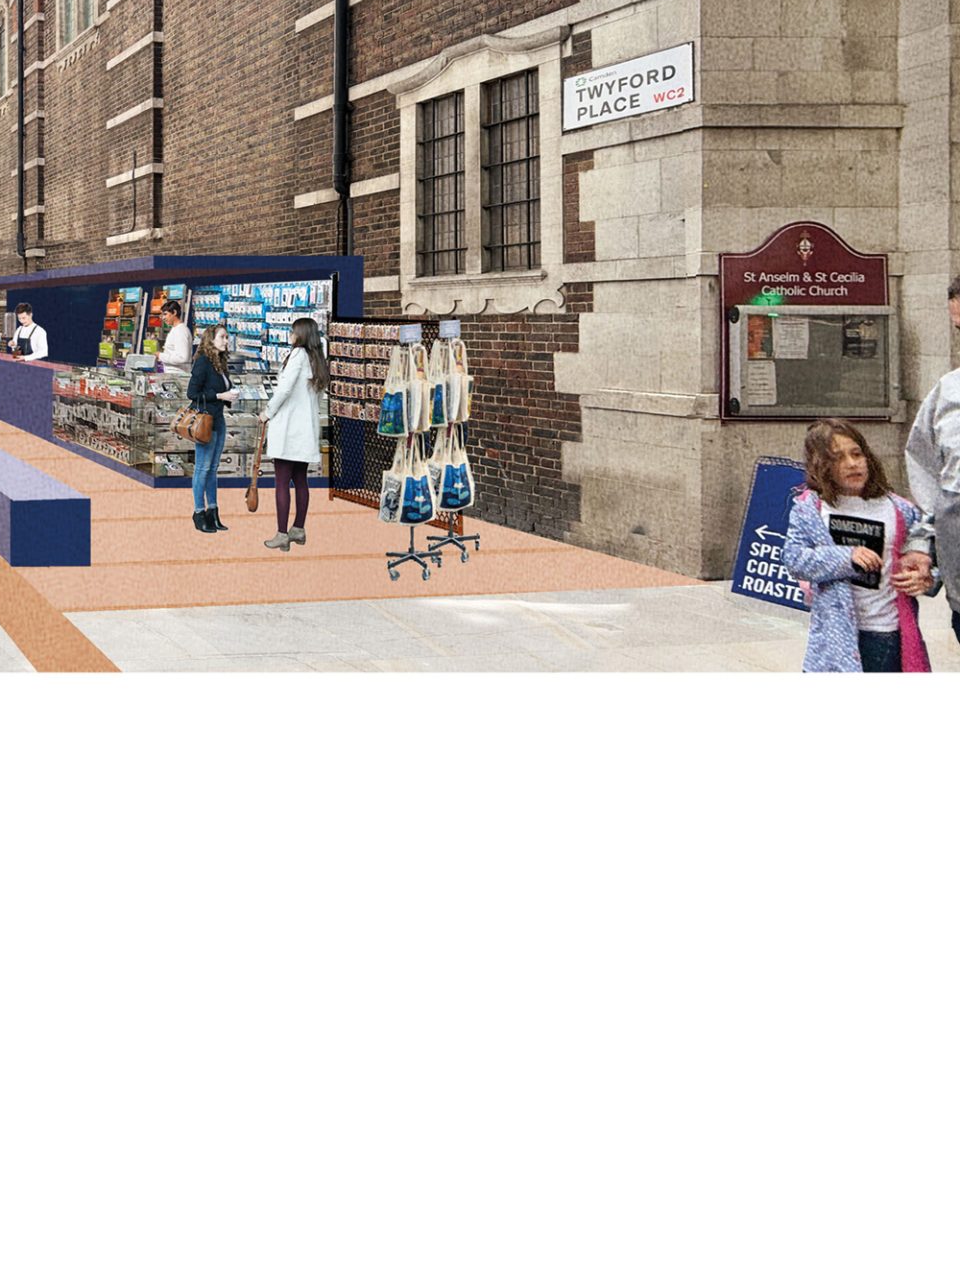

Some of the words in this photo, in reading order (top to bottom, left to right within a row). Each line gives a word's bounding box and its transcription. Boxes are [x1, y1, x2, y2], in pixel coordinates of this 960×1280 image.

[576, 65, 676, 102] TWYFORD
[577, 93, 640, 121] PLACE
[653, 87, 685, 103] WC2
[744, 272, 755, 282] St
[758, 272, 799, 282] Anselm
[803, 272, 812, 282] &
[815, 272, 826, 282] St
[830, 272, 865, 282] Cecilia
[761, 285, 806, 296] Catholic
[809, 285, 848, 296] Church
